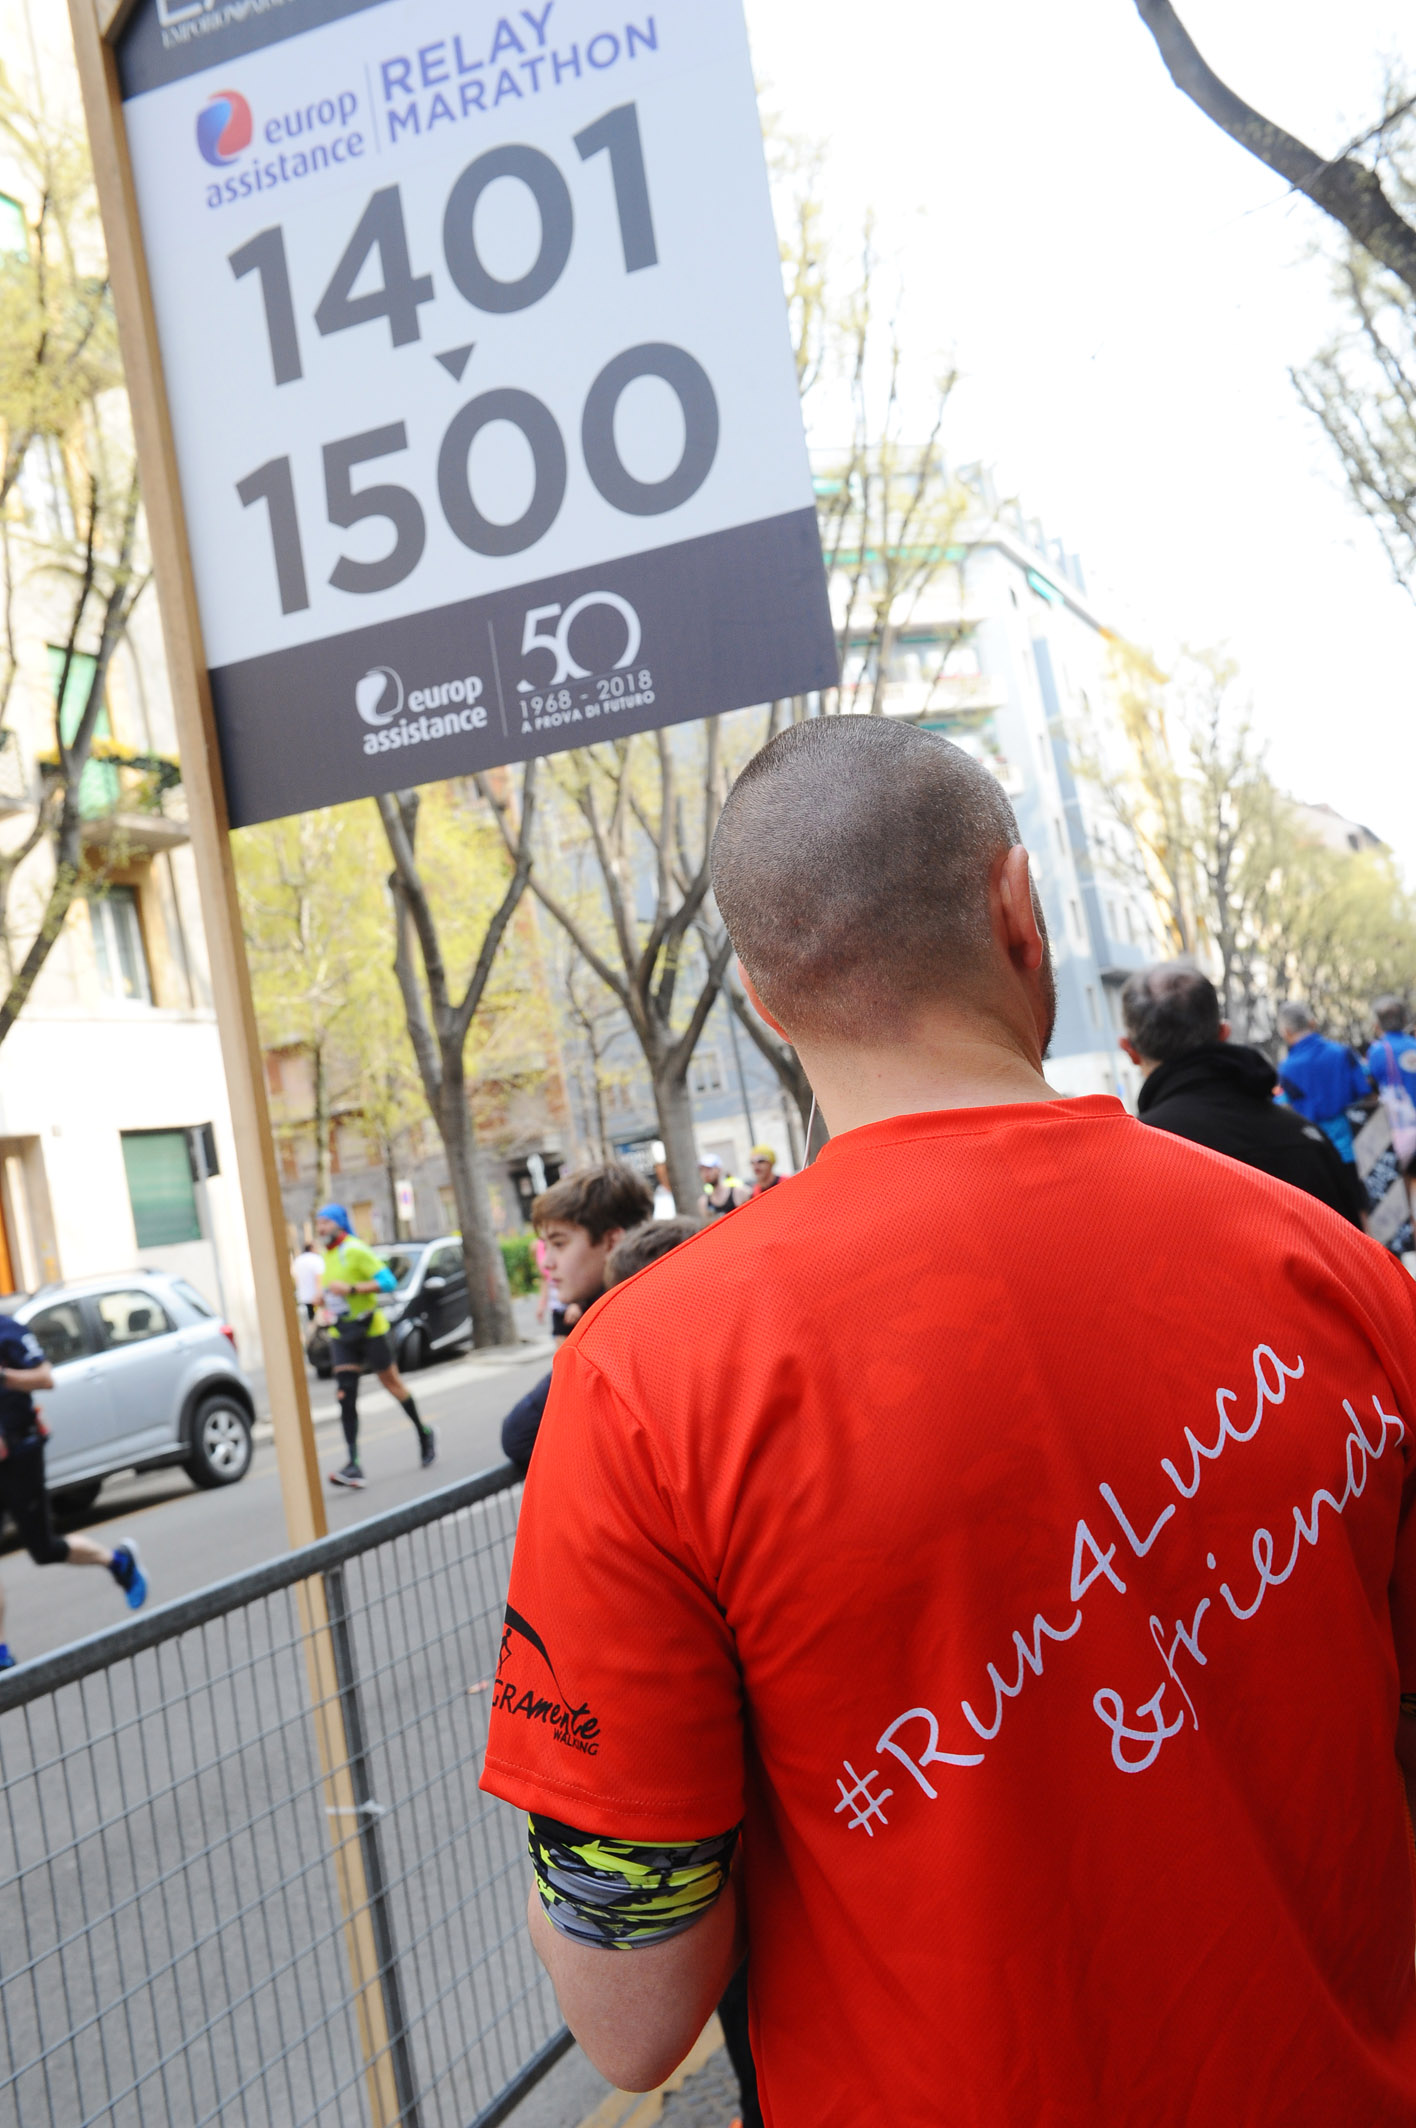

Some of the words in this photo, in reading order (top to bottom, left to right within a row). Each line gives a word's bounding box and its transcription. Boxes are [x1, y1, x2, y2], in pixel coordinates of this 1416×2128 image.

[379, 1, 554, 101] RELAY
[387, 16, 659, 142] MARATHON
[264, 91, 358, 144] europ
[206, 131, 364, 209] assistance
[227, 100, 659, 387] 1401
[234, 341, 720, 616] 1500
[516, 591, 642, 693] 50
[408, 676, 483, 713] europ
[519, 689, 572, 719] 1968
[596, 669, 653, 700] 2018
[521, 720, 533, 734] A
[534, 708, 583, 731] PROVA
[584, 703, 602, 719] DI
[603, 690, 656, 714] FUTURO
[363, 706, 488, 755] assistance
[553, 1727, 600, 1756] WALKING
